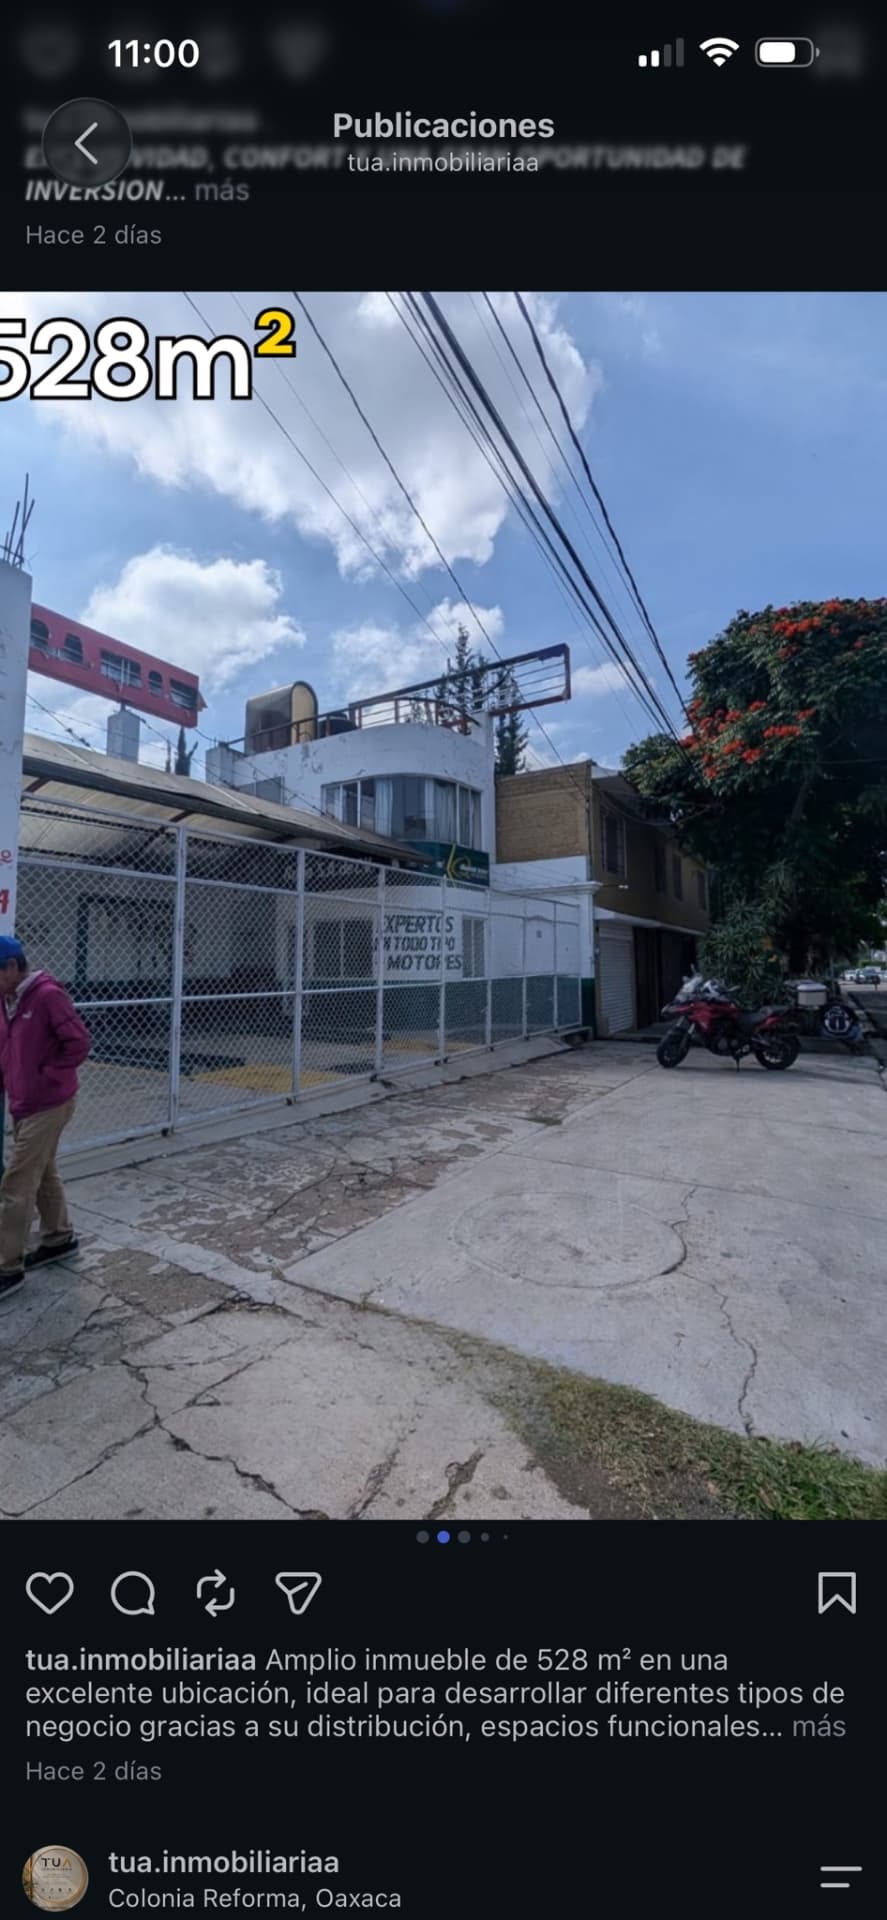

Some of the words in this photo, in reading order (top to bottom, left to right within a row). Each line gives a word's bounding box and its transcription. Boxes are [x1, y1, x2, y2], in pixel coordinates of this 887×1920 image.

[108, 39, 199, 67] 11:00
[334, 111, 554, 138] Publicaciones
[348, 151, 538, 172] tua.inmobiliariaa
[195, 178, 249, 201] más
[26, 225, 85, 244] Hace
[93, 225, 107, 244] 2
[115, 223, 162, 245] días
[25, 1647, 256, 1672] tua.inmobiliariaa
[265, 1648, 357, 1676] Amplio
[365, 1648, 487, 1671] inmueble
[495, 1648, 528, 1671] de
[537, 1648, 589, 1671] 528
[639, 1654, 672, 1671] en
[680, 1654, 728, 1671] una
[25, 1680, 153, 1705] excelente
[162, 1680, 296, 1709] ubicación,
[306, 1680, 368, 1705] ideal
[377, 1686, 436, 1709] para
[444, 1680, 588, 1705] desarrollar
[595, 1680, 730, 1705] diferentes
[736, 1680, 804, 1709] tipos
[812, 1680, 845, 1705] de
[26, 1713, 132, 1742] negocio
[139, 1713, 236, 1742] gracias
[244, 1720, 259, 1737] a
[268, 1720, 299, 1738] su
[307, 1713, 471, 1742] distribución,
[480, 1713, 599, 1742] espacios
[793, 1713, 846, 1738] más
[26, 1761, 85, 1781] Hace
[93, 1761, 107, 1781] 2
[115, 1760, 162, 1781] días
[108, 1849, 339, 1874] tua.inmobiliariaa
[108, 1887, 195, 1908] Colonia
[203, 1887, 307, 1913] Reforma,
[315, 1887, 401, 1908] Oaxaca
